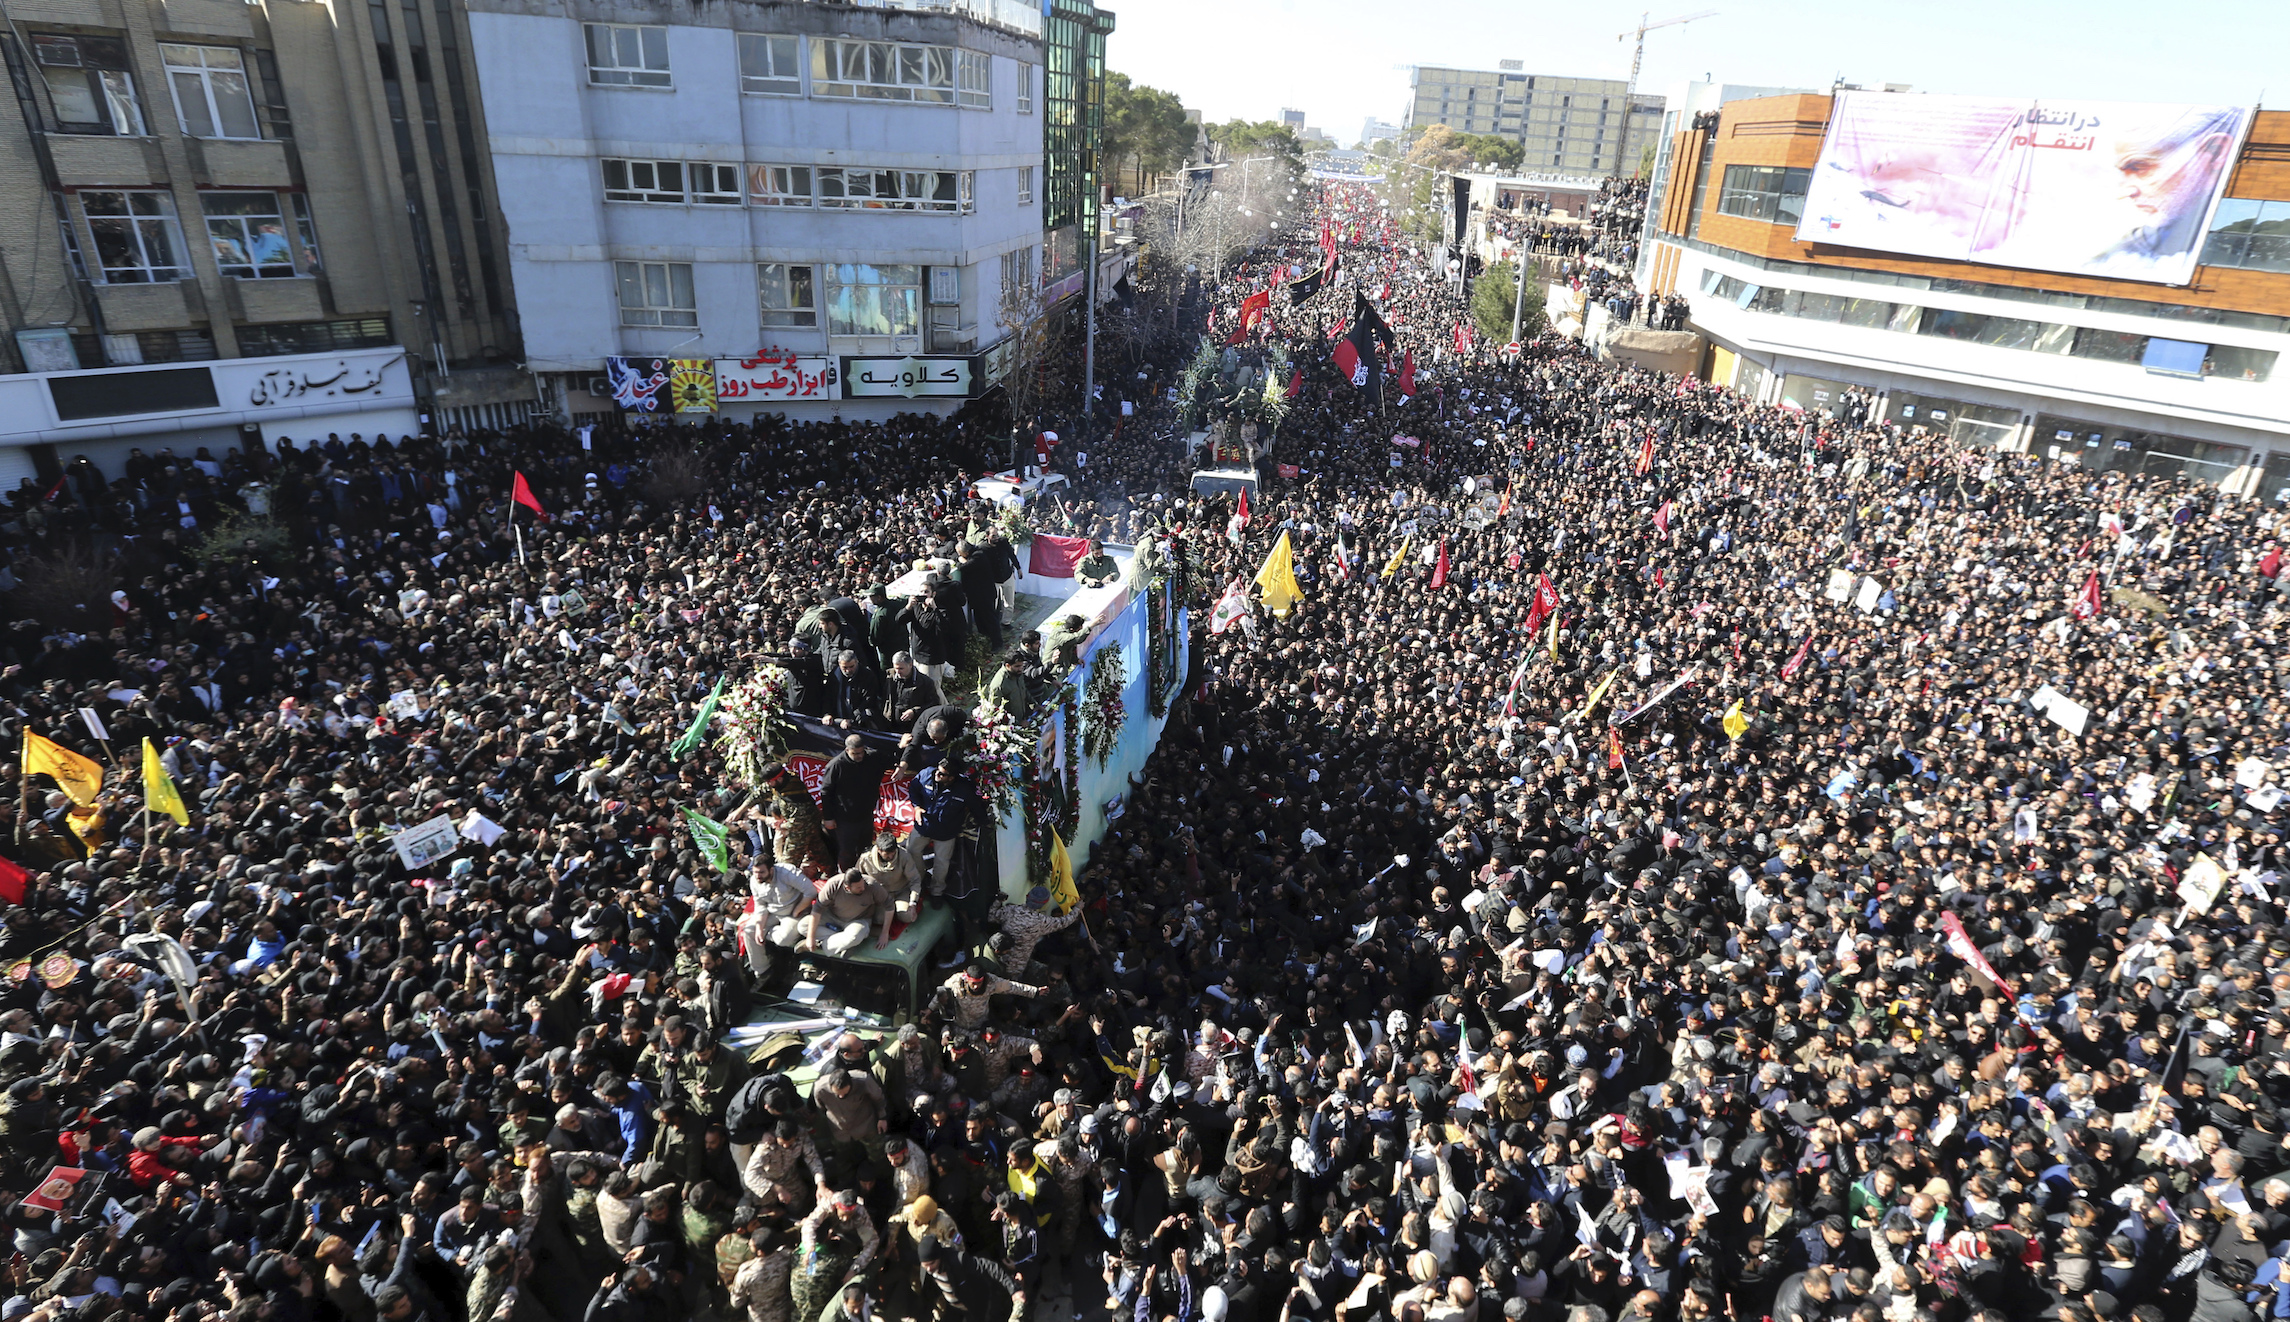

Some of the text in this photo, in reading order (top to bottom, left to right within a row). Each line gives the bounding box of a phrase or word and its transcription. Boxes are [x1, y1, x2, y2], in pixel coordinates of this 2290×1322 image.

[2012, 108, 2101, 132] در انتظار
[2009, 132, 2095, 151] انتقام
[740, 345, 797, 374] پزشکی
[250, 355, 401, 406] کیف نیلوفر آبی
[613, 359, 670, 410] غبار
[718, 374, 749, 397] روز
[750, 369, 789, 396] طب
[786, 369, 826, 396] ابزار
[860, 366, 960, 388] کلاویه
